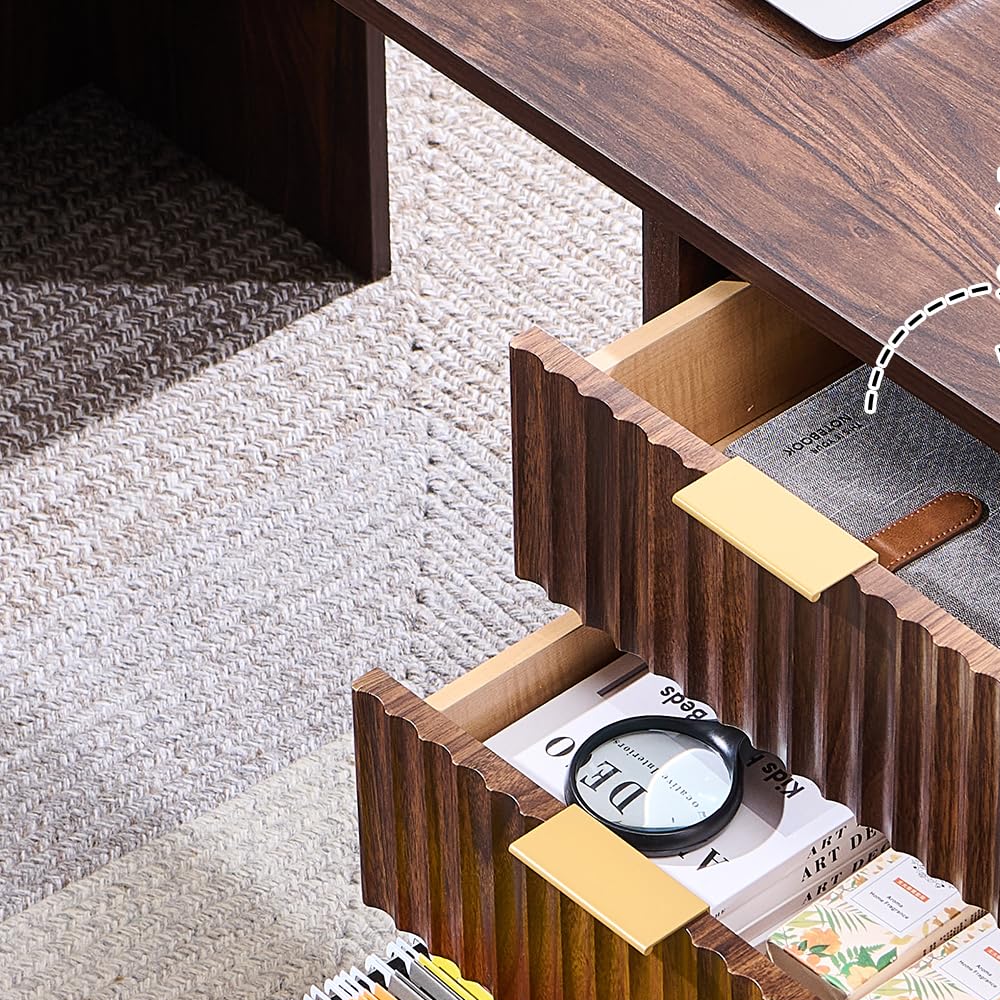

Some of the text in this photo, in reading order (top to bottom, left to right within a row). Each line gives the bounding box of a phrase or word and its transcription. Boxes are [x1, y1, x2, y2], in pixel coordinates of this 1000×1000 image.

[783, 413, 852, 457] NOTEBOOK
[660, 685, 708, 721] Beds
[761, 761, 804, 800] Kids
[801, 827, 877, 882] ART DE
[807, 825, 847, 859] ART
[802, 871, 843, 904] ART
[887, 895, 904, 908] Aroma
[870, 891, 909, 920] Home Fragrance
[959, 960, 998, 988] Home Fragrance
[976, 964, 993, 977] Aroma
